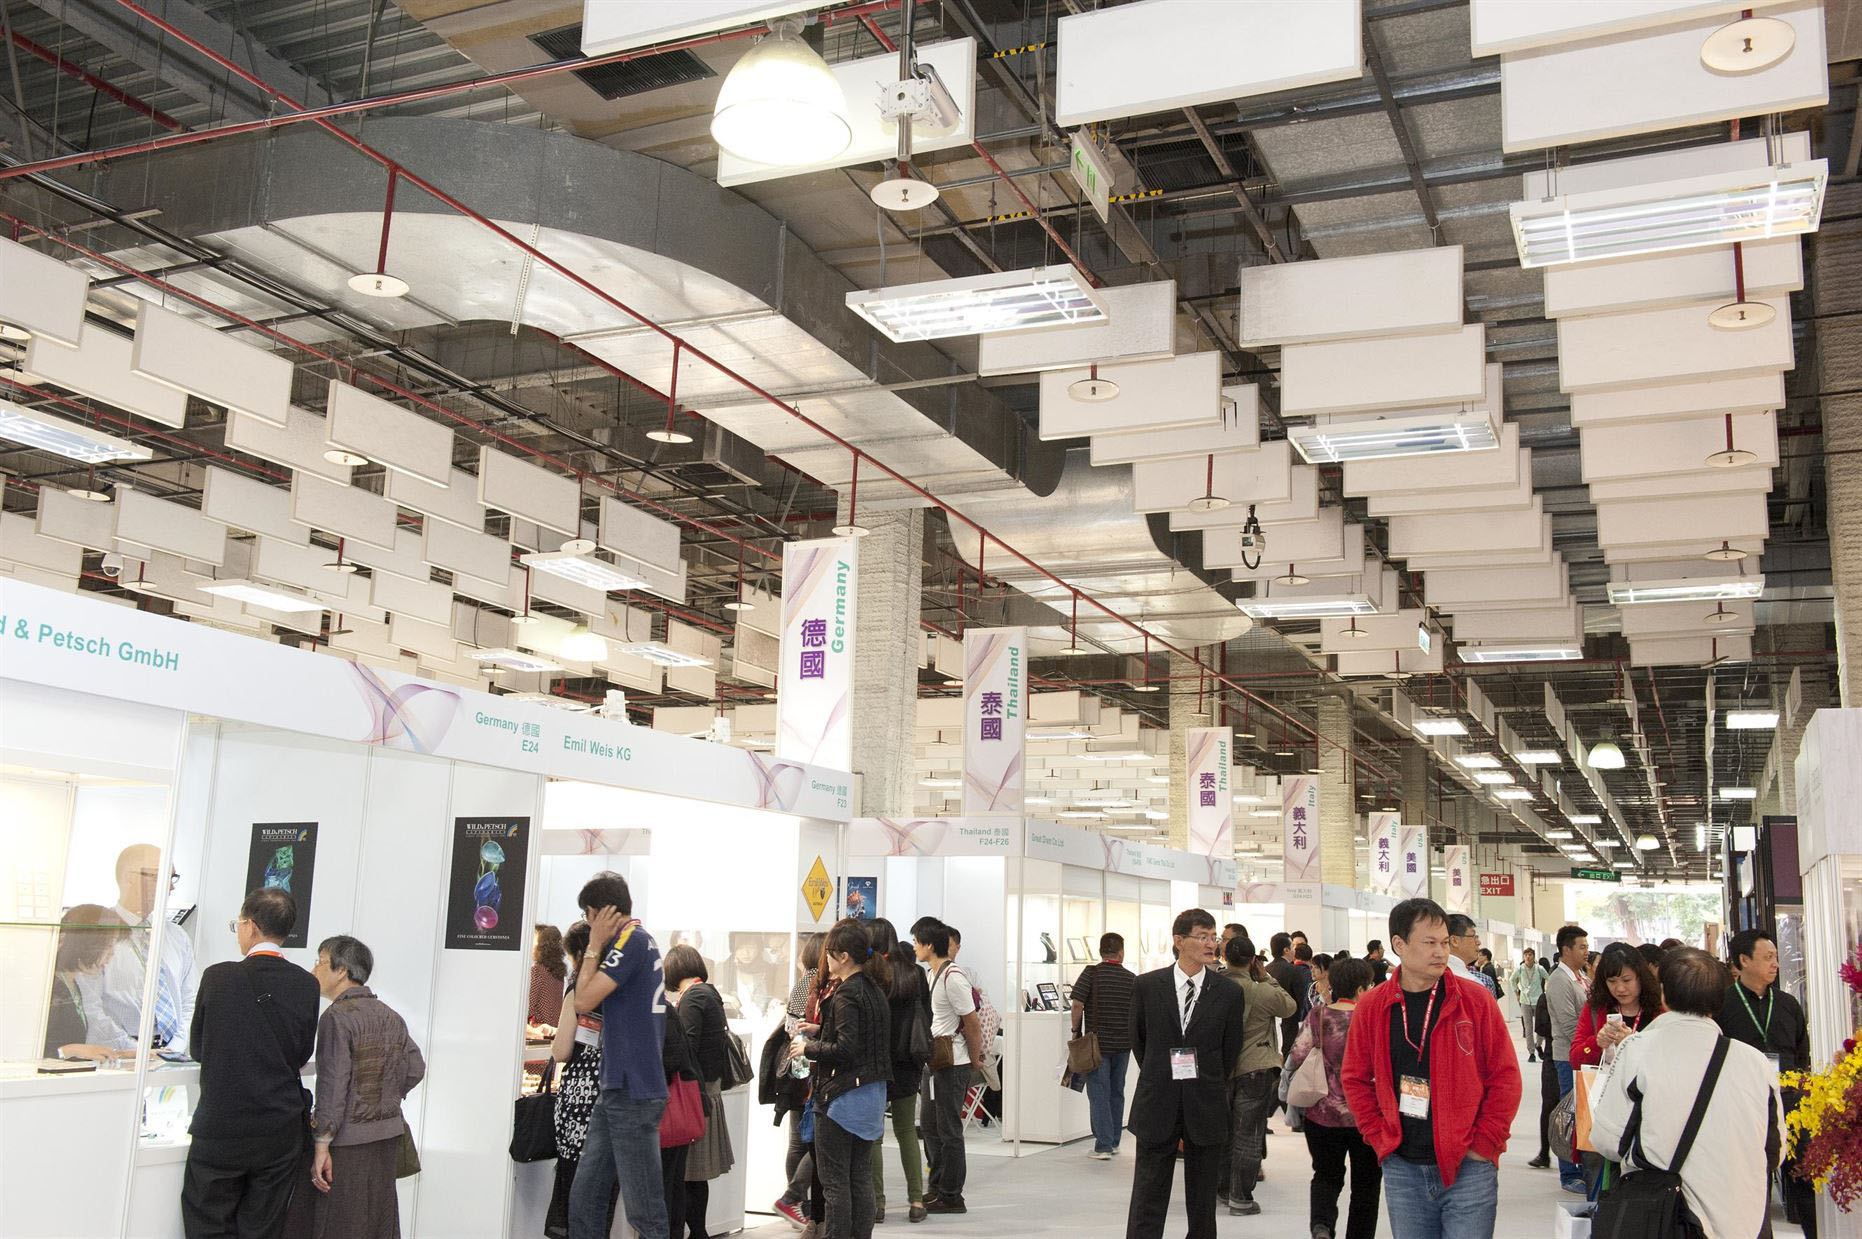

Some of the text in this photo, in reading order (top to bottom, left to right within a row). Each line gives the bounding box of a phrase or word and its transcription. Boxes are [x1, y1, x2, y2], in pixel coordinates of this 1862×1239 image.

[831, 559, 850, 654] Germany
[14, 618, 30, 641] &
[38, 623, 111, 657] Petsch
[118, 642, 179, 671] GmbH
[800, 618, 827, 680] 德國
[1006, 646, 1019, 720] Thailand
[475, 711, 541, 738] Germany 德國
[981, 691, 1002, 741] 泰國
[521, 739, 539, 753] E24
[563, 735, 632, 761] Emil Weis KG
[1218, 739, 1228, 793] Thailand
[811, 779, 836, 796] Germany
[1199, 772, 1216, 807] 泰國
[1308, 784, 1317, 807] Italy
[959, 827, 992, 836] Thailand
[979, 837, 1010, 846] F24-F26
[1293, 806, 1307, 850] 義大利
[1391, 819, 1399, 838] Italy
[1378, 837, 1390, 873] 義大利
[1406, 852, 1417, 873] 美國
[1480, 887, 1502, 895] EXIT
